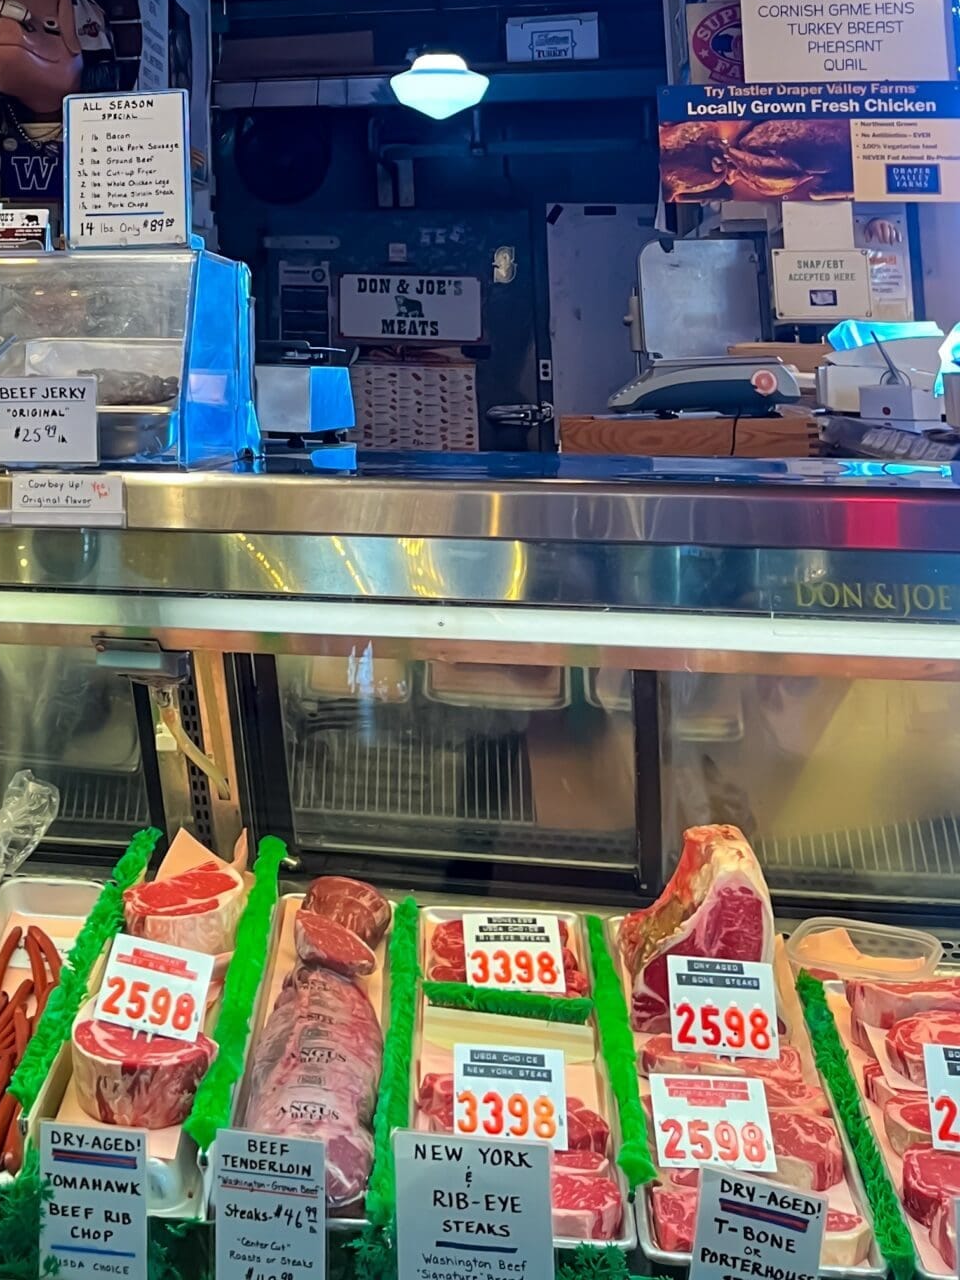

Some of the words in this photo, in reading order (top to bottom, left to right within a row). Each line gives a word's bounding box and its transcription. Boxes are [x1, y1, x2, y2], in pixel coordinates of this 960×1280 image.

[758, 4, 823, 18] CORNISH
[828, 3, 871, 17] GAME
[875, 2, 915, 15] HENS
[787, 22, 843, 36] TURKEY
[848, 20, 904, 34] BREAST
[808, 39, 883, 53] PHEASANT
[823, 58, 868, 72] QUAIL
[704, 86, 725, 98] Try
[728, 85, 775, 96] Tastier
[778, 85, 824, 98] Draper
[826, 84, 866, 96] Valley
[870, 83, 916, 94] Farms
[82, 102, 102, 112] ALL
[109, 99, 154, 110] SEASON
[687, 101, 746, 117] Locally
[751, 100, 806, 113] Grown
[811, 100, 860, 113] Fresh
[865, 99, 936, 112] Chicken
[11, 156, 58, 190] W
[892, 167, 931, 175] DRAPER
[80, 222, 94, 236] 14
[100, 224, 114, 233] lbs
[120, 223, 140, 236] Only
[797, 260, 845, 270] SNAP/EBT
[788, 273, 830, 282] ACCEPTED
[834, 272, 856, 281] HERE
[357, 278, 390, 294] DON
[396, 279, 409, 294] &
[415, 279, 463, 296] JOE'S
[381, 319, 439, 336] MEATS
[0, 386, 36, 400] BEEF
[40, 386, 86, 400] JERKY
[796, 583, 862, 608] DON
[874, 583, 896, 609] &
[51, 1131, 141, 1152] DRY-AGED!
[248, 1139, 290, 1155] BEEF
[414, 1144, 463, 1161] NEW
[478, 1147, 533, 1168] YORK
[222, 1154, 312, 1177] TENDERLOIN
[44, 1172, 141, 1196] TOMAHAWK
[433, 1190, 522, 1213] RIB-EYE
[720, 1178, 822, 1219] DRY-AGED!
[49, 1203, 93, 1219] BEEF
[104, 1209, 132, 1225] RIB
[70, 1226, 114, 1242] CHOP
[442, 1220, 510, 1237] STEAKS
[714, 1217, 796, 1253] T-BONE
